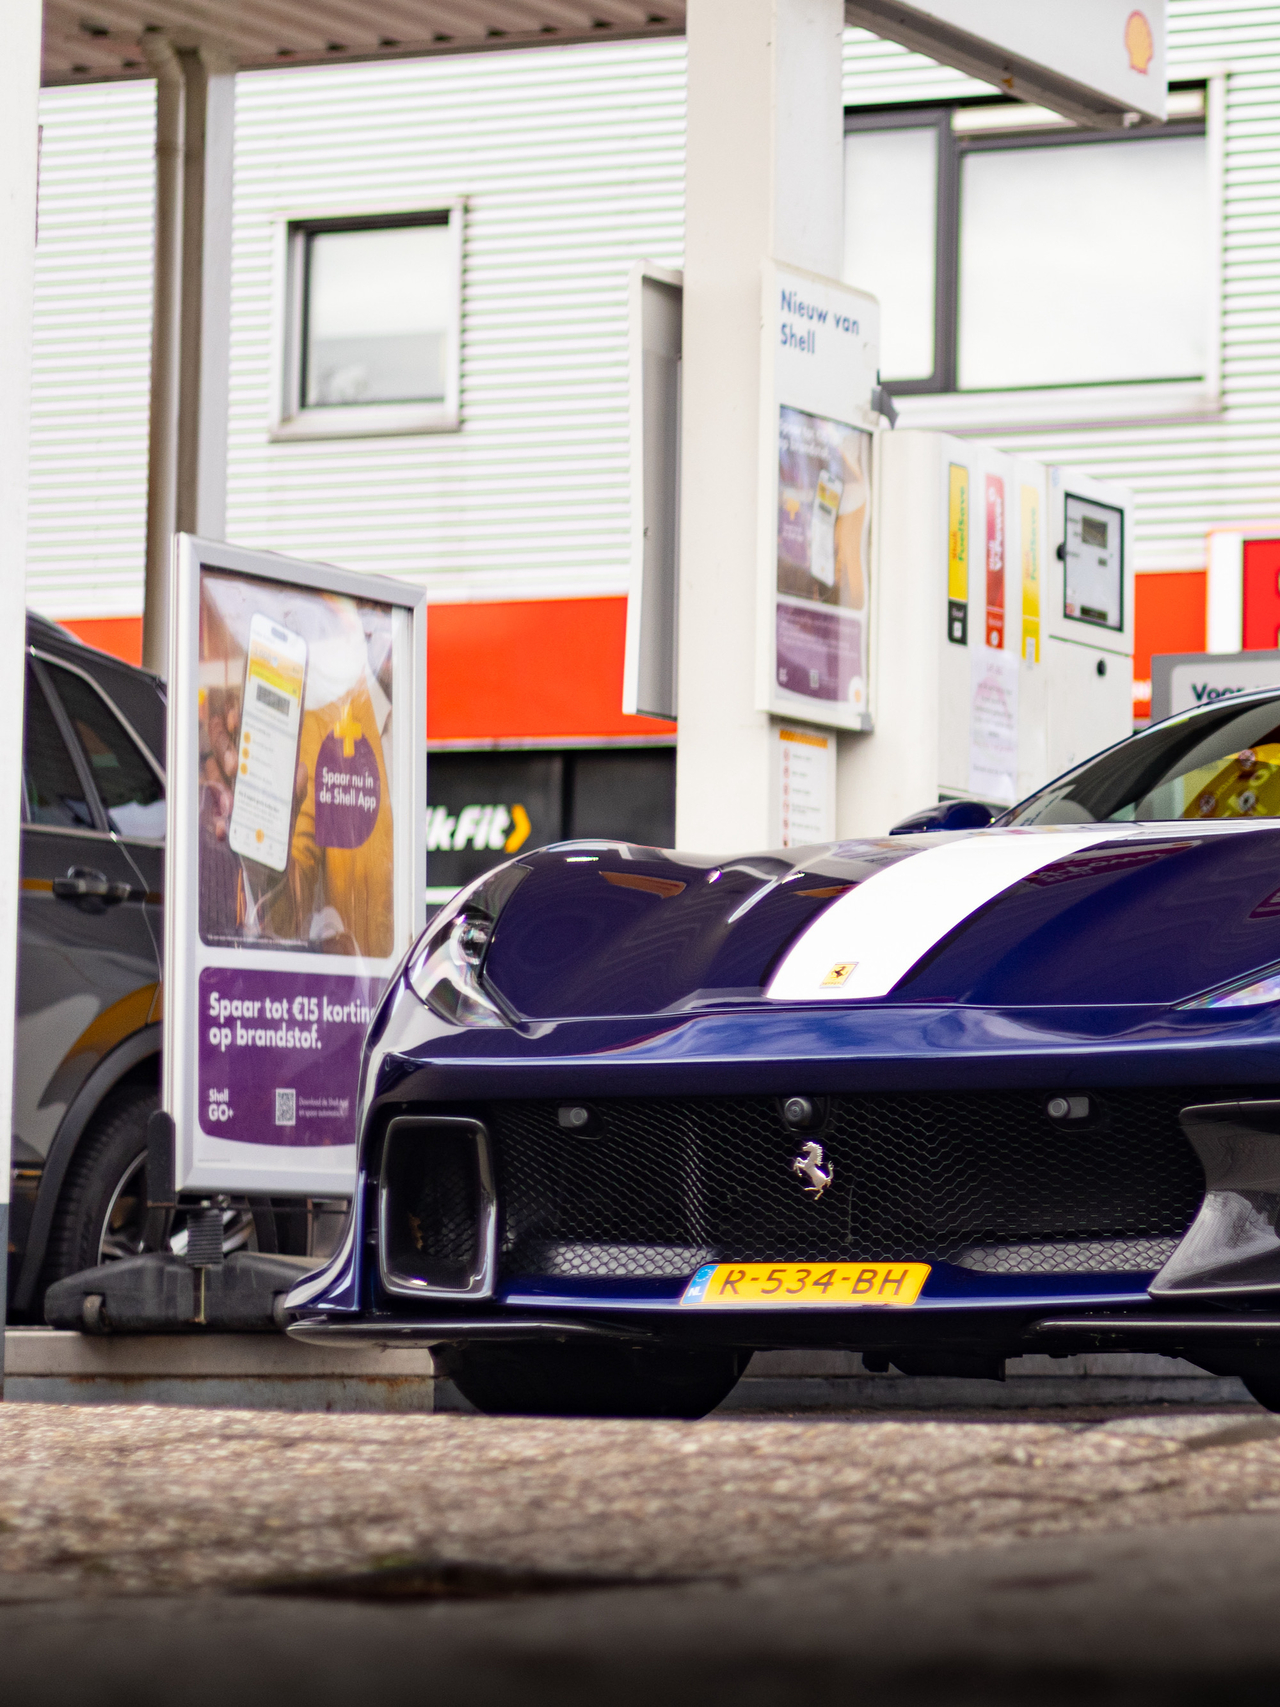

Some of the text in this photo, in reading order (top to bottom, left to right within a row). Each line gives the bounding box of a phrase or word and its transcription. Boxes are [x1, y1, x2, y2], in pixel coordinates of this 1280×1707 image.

[781, 289, 859, 336] Nieuw van
[781, 323, 815, 354] Shell
[322, 766, 374, 789] Spaar nu in
[319, 784, 377, 813] de Shell App
[209, 991, 261, 1024] Spaar
[265, 997, 289, 1020] tot
[292, 995, 319, 1022] €15
[209, 1019, 322, 1053] op brandstof.
[209, 1087, 229, 1103] Shell
[687, 1286, 703, 1298] NL
[718, 1268, 909, 1296] R-534-BH
